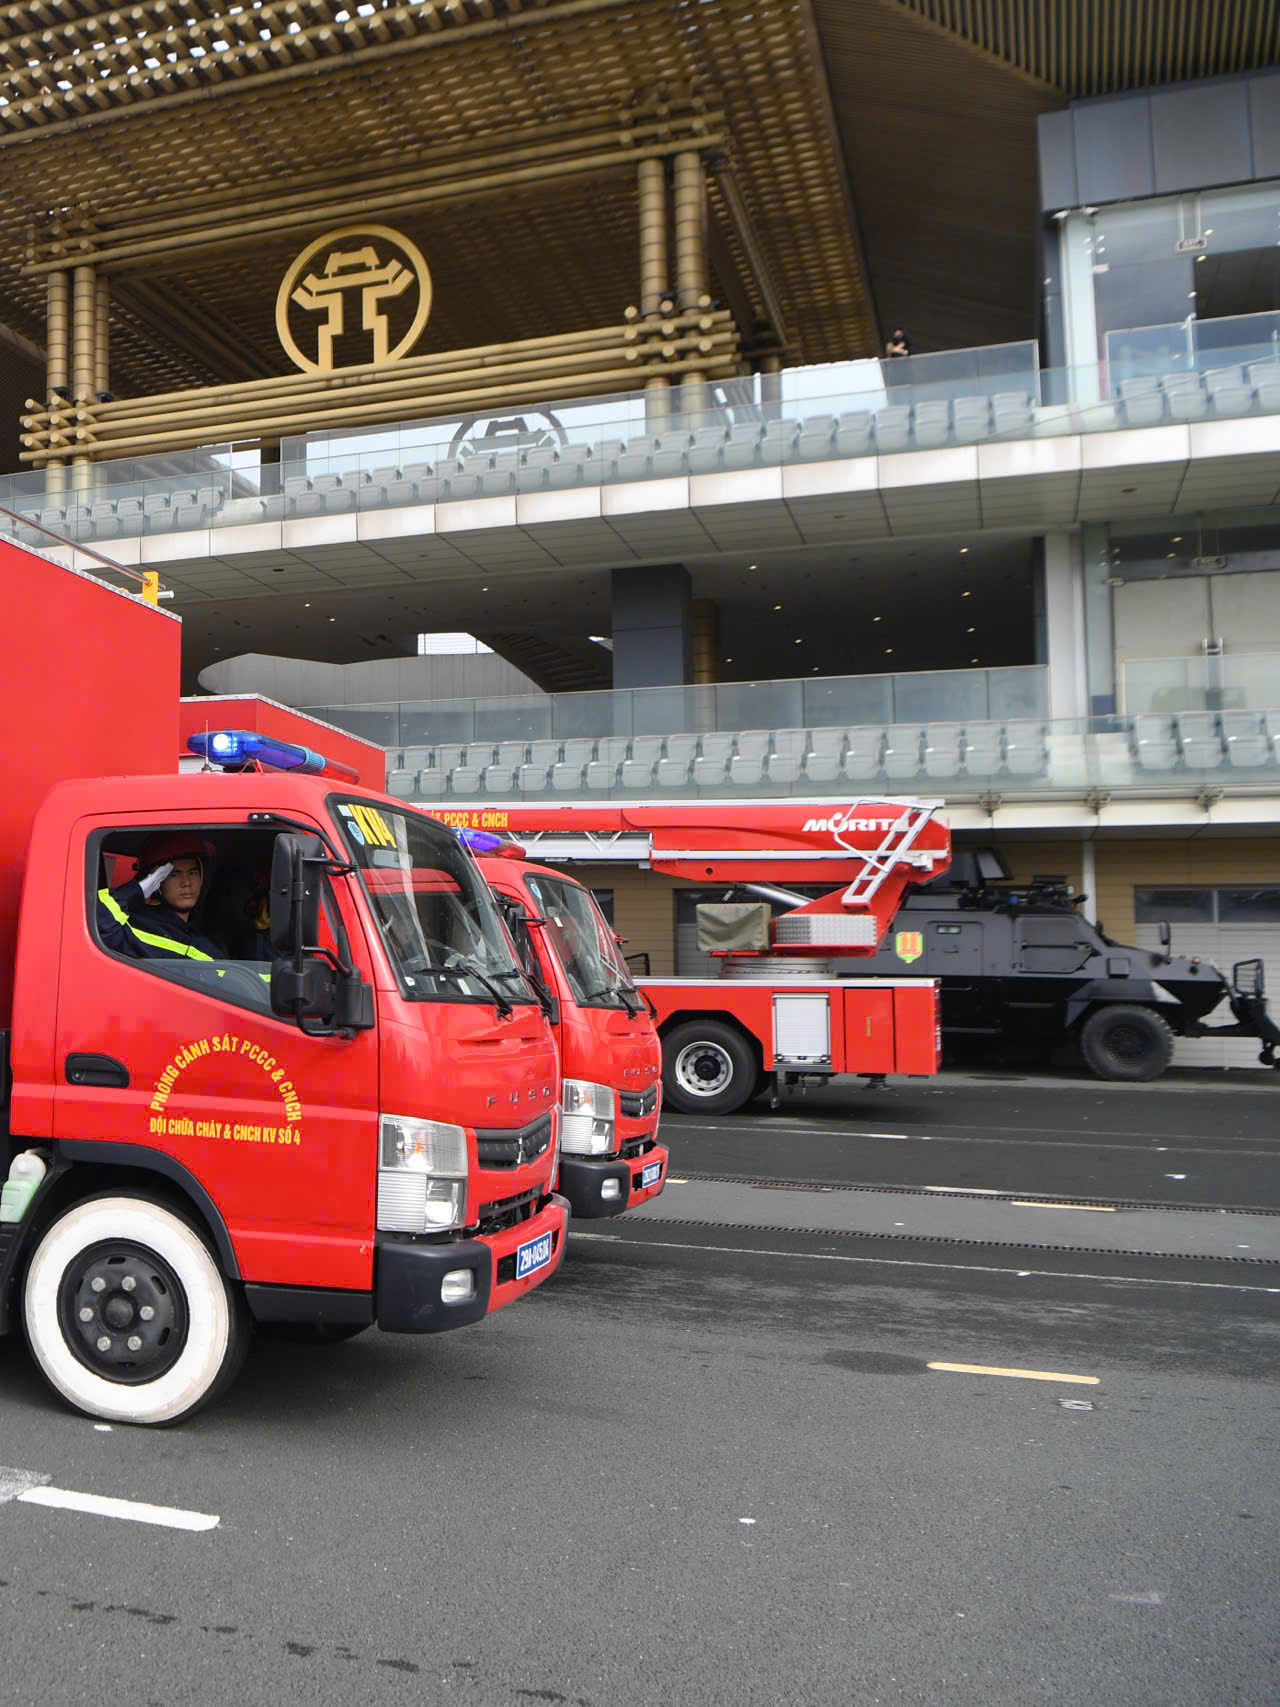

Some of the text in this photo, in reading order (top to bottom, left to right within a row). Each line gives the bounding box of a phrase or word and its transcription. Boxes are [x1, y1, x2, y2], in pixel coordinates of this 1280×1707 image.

[444, 812, 469, 828] PCCC
[472, 812, 479, 827] &
[481, 812, 509, 828] CNCH
[801, 812, 912, 832] MORIT
[212, 1033, 239, 1052] SÁT
[240, 1040, 277, 1071] PCCC
[271, 1068, 285, 1082] &
[278, 1081, 302, 1121] CNCH
[487, 1086, 551, 1109] FUSO
[196, 1119, 222, 1138] CHÁY
[223, 1123, 232, 1139] &
[233, 1124, 261, 1142] CNCH
[262, 1127, 277, 1143] KV
[294, 1129, 301, 1145] 4
